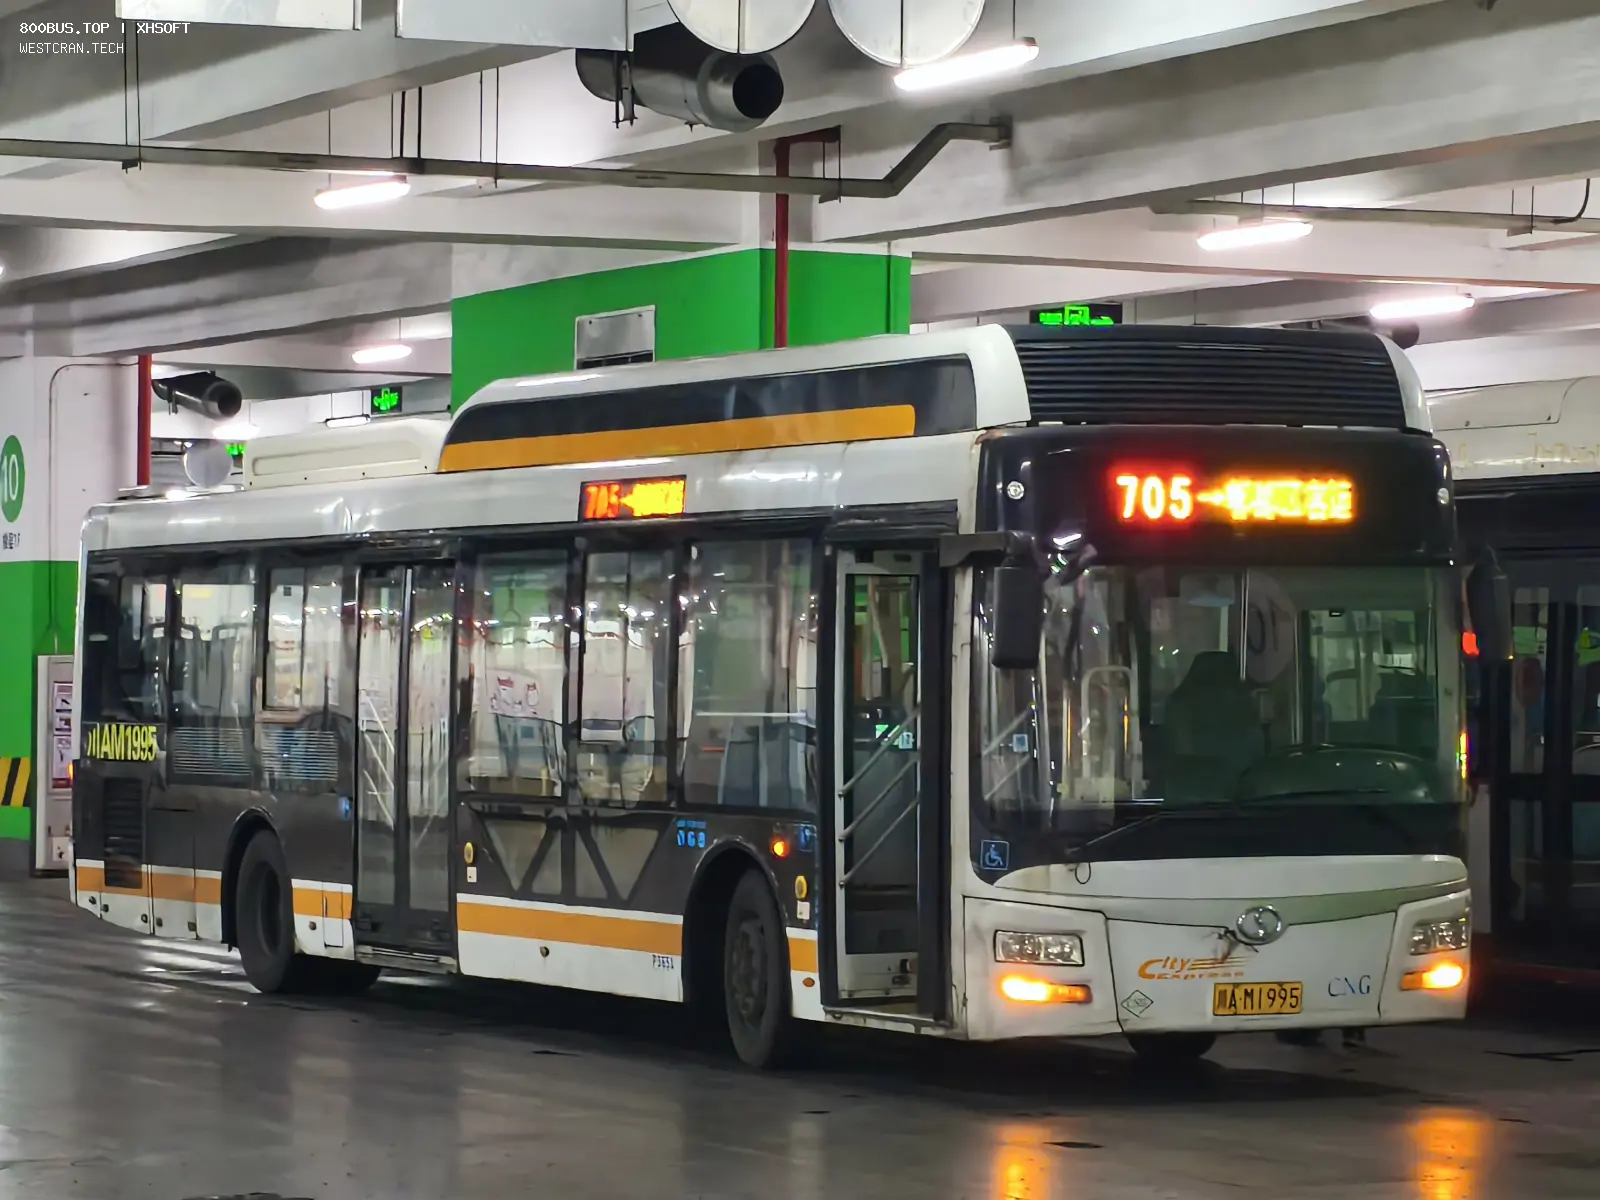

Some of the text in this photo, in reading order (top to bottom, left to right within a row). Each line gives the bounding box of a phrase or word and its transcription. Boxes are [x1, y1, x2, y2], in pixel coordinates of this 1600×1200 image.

[2, 453, 19, 503] 10
[1116, 475, 1195, 519] 705
[86, 722, 158, 761] 川AM1995
[1327, 974, 1371, 997] CNG
